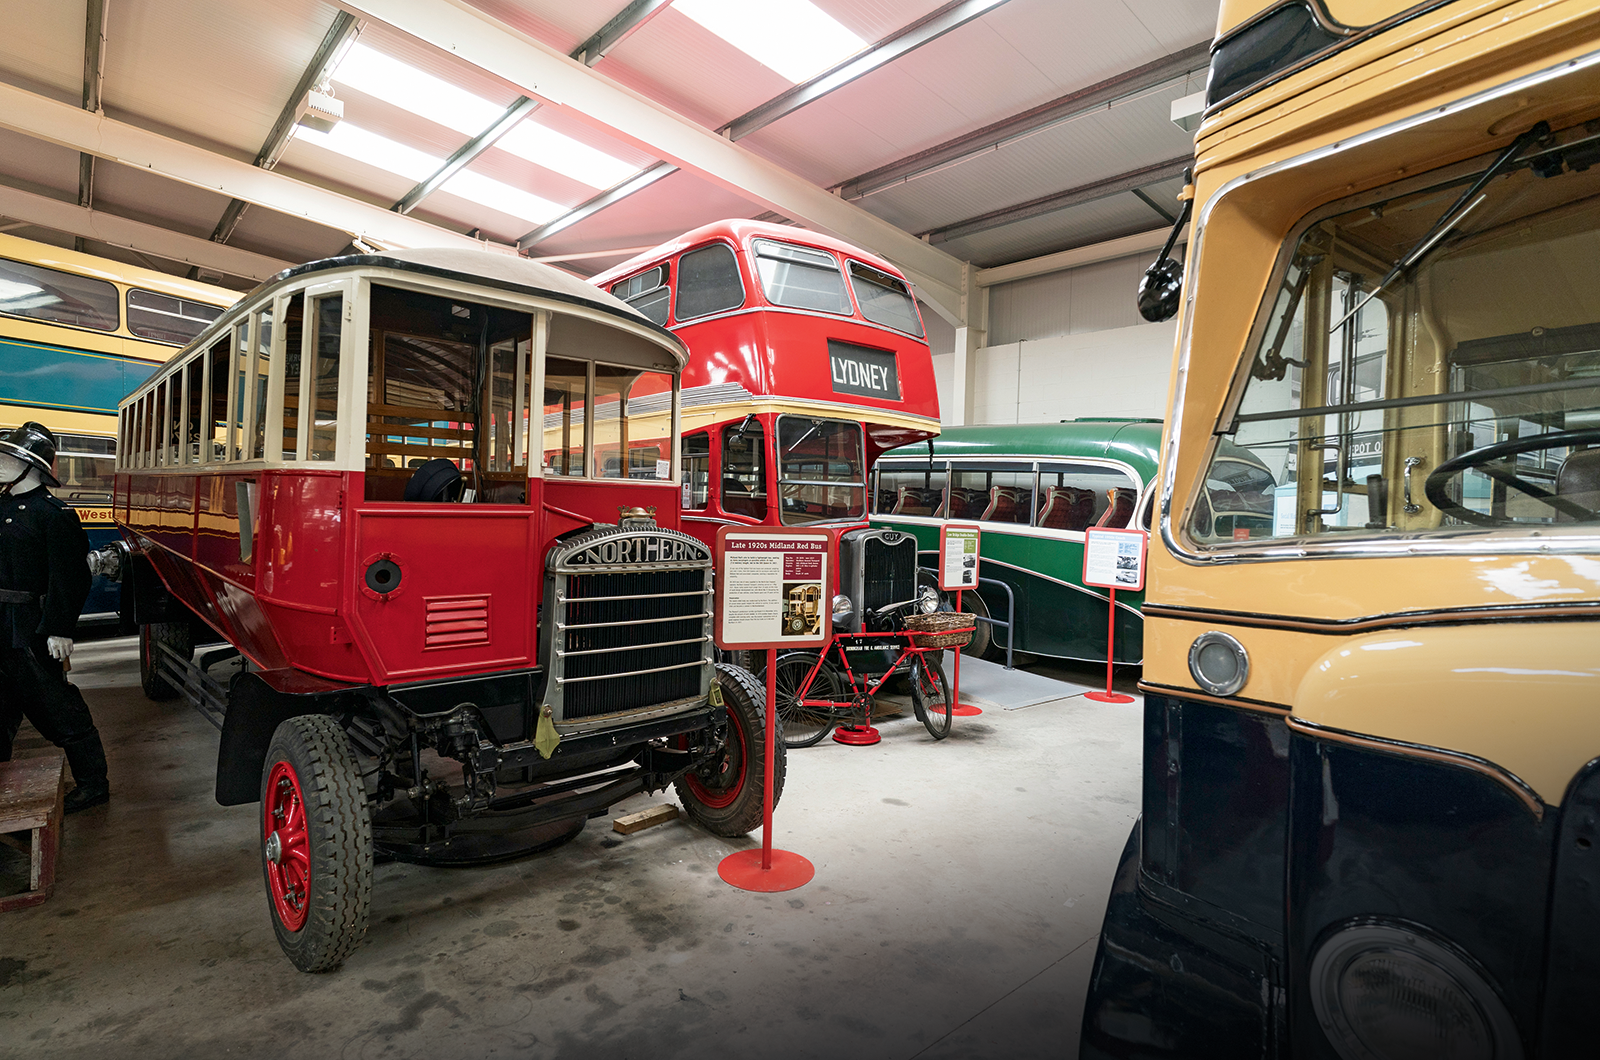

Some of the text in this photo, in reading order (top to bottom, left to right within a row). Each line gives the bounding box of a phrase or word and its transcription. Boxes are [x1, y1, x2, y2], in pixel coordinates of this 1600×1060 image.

[831, 356, 888, 391] LYDNEY
[796, 542, 809, 550] Red
[884, 533, 899, 541] GUY
[585, 537, 698, 565] NORTHERN
